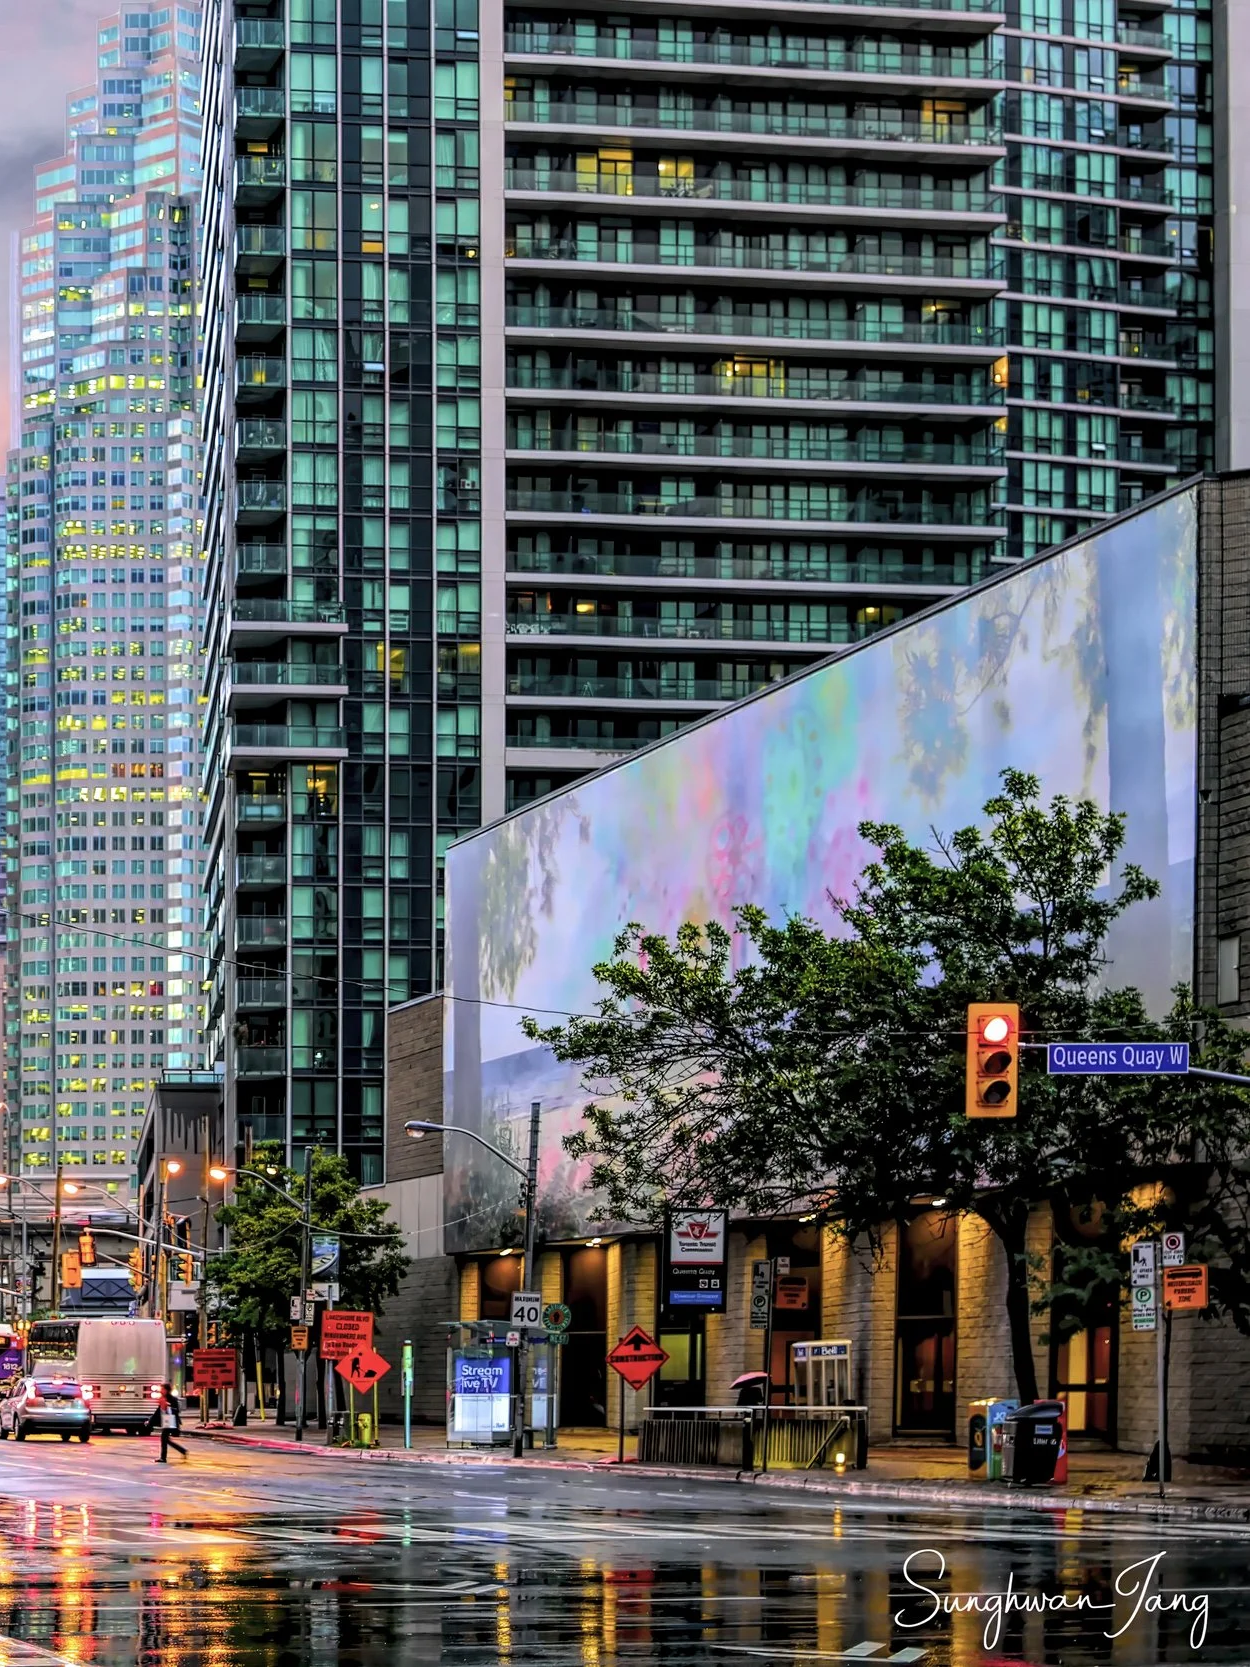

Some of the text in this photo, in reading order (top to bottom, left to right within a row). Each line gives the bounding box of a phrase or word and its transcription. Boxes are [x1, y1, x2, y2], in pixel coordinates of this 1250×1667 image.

[1053, 1046, 1184, 1070] Queens Quay W
[513, 1306, 539, 1322] 40
[336, 1322, 360, 1330] CLOSED
[461, 1364, 503, 1376] Stream
[462, 1376, 499, 1388] live TV
[1033, 1437, 1048, 1445] Litter
